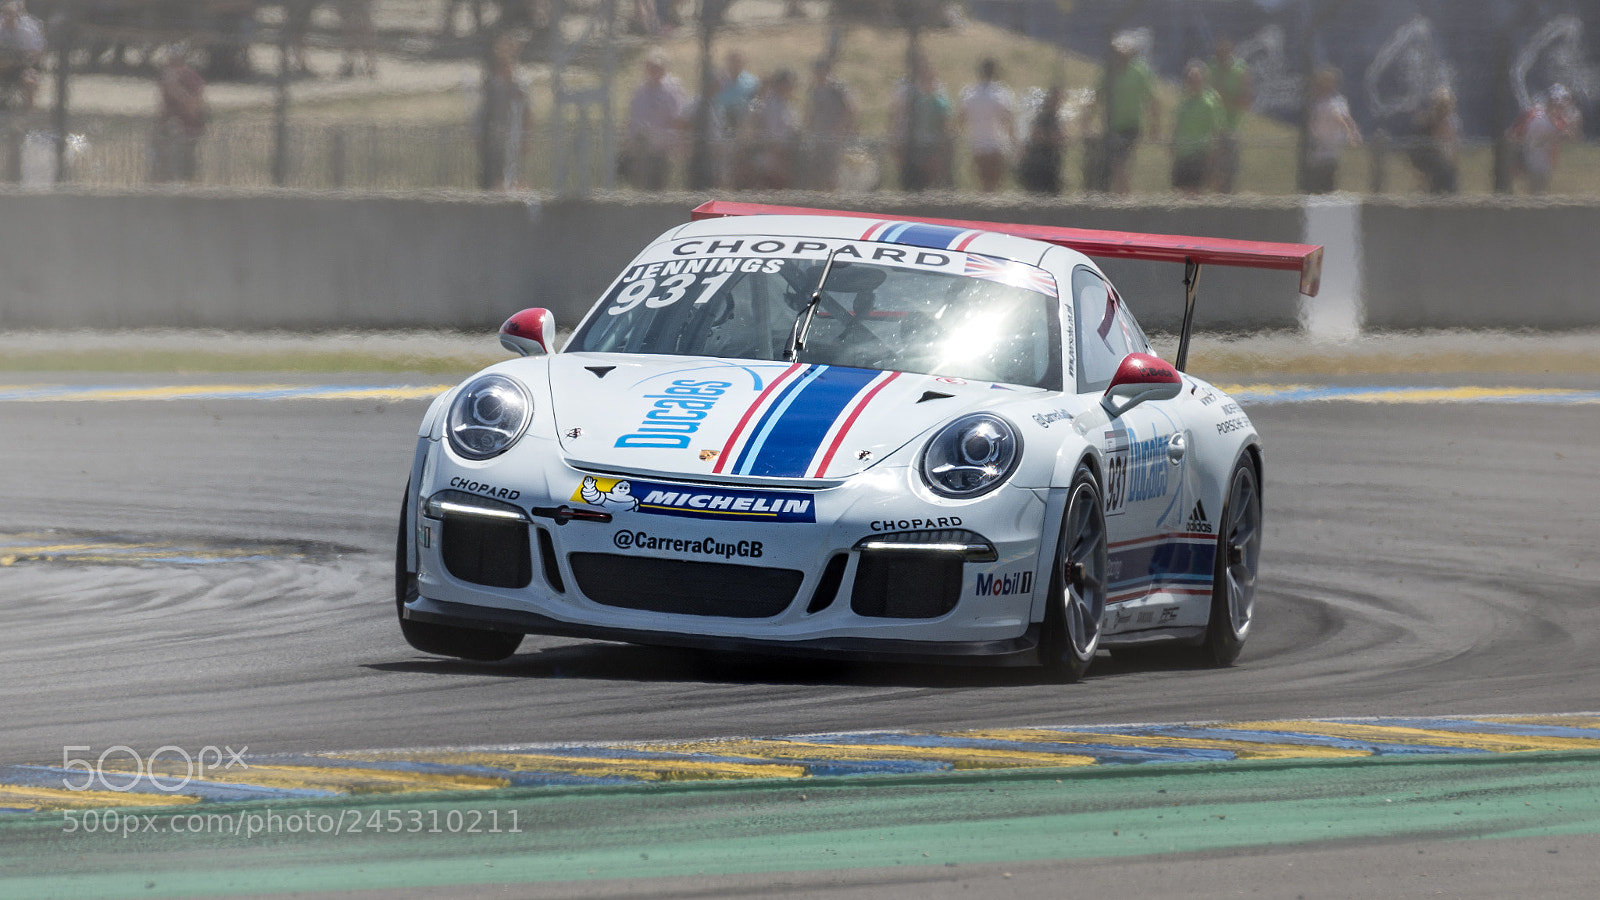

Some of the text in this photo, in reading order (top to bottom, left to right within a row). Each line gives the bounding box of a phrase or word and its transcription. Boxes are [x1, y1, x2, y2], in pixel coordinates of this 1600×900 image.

[672, 239, 951, 267] CHOPARD
[623, 257, 785, 283] JENNINGS
[607, 272, 734, 316] 931
[613, 379, 732, 449] Ducales
[450, 476, 520, 500] CHOPARD
[1105, 456, 1127, 512] 931
[646, 490, 810, 513] MICHELIN
[870, 516, 963, 531] CHOPARD
[1186, 521, 1212, 533] adidas
[613, 529, 763, 559] @CarreraCupGB
[976, 571, 1033, 596] Mobil 1
